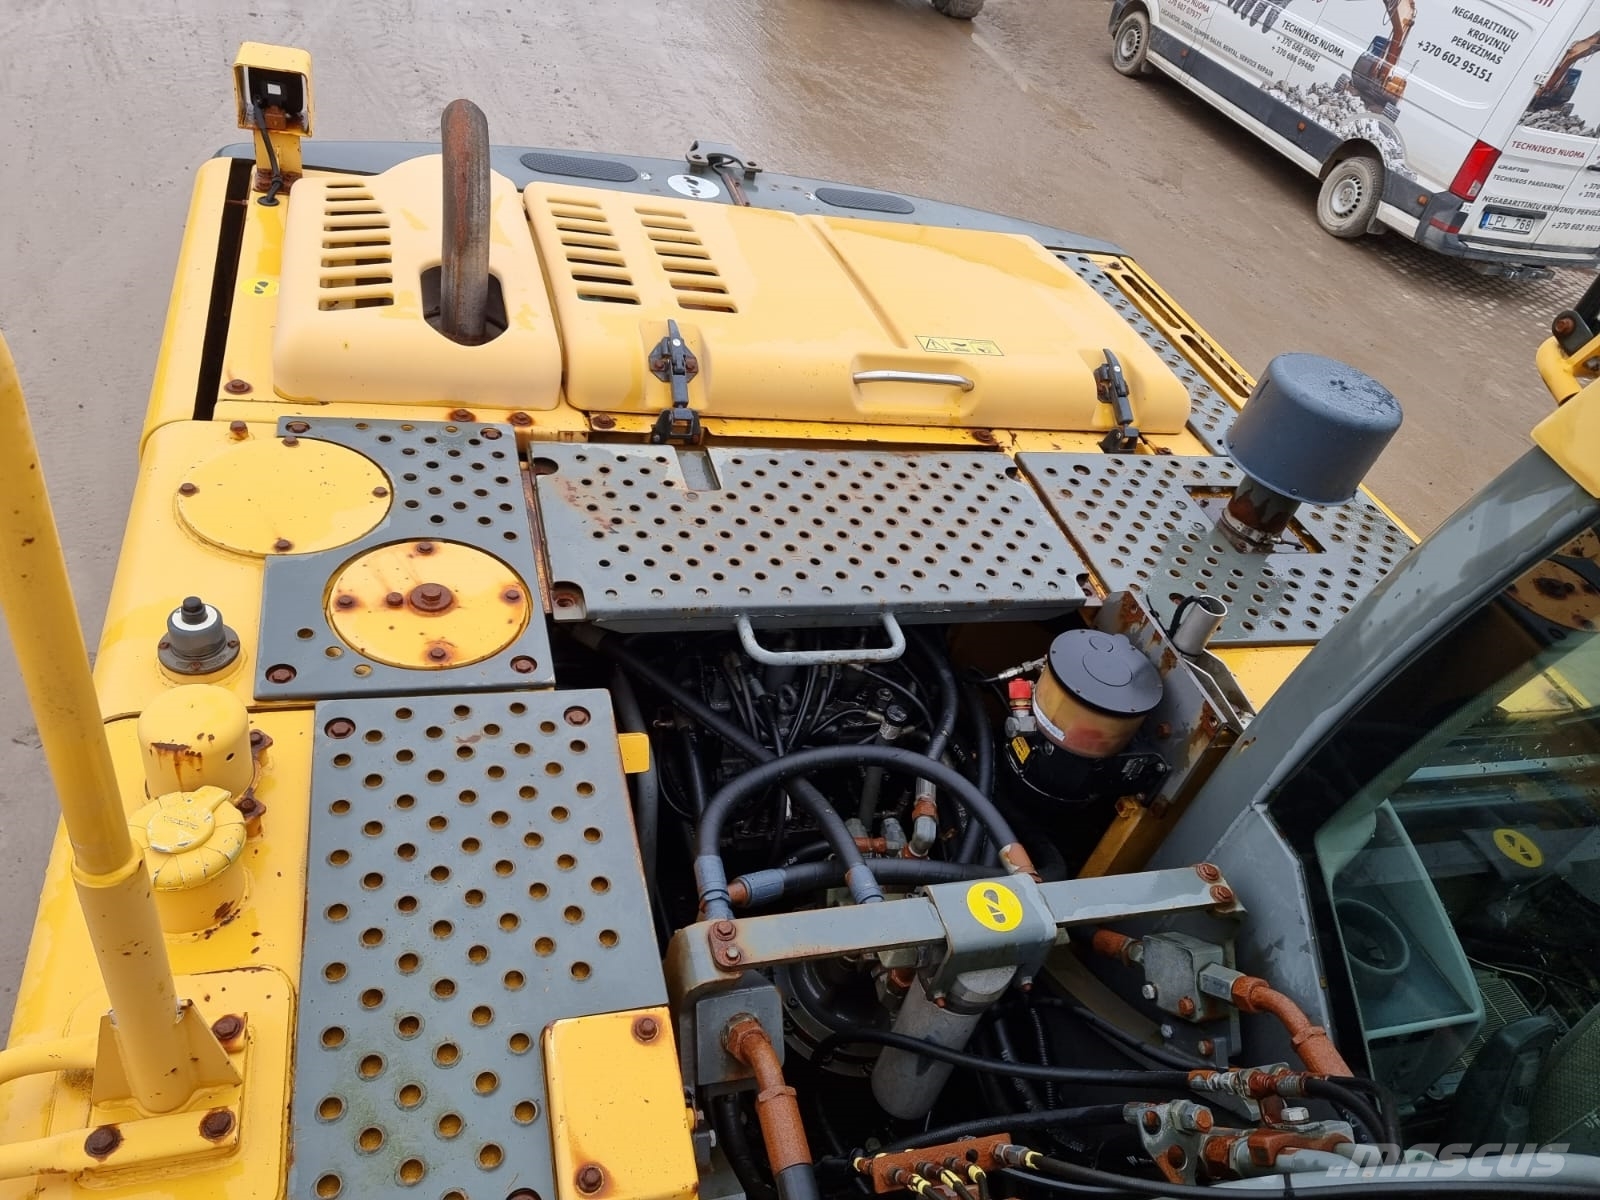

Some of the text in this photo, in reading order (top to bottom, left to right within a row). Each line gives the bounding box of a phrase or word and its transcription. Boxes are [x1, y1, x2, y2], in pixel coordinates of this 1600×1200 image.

[1451, 5, 1519, 41] NEGABARITINIŲ
[1281, 20, 1345, 59] TECHNIKOS NUOMA
[1450, 36, 1503, 65] PERVEŽIMAS
[1467, 27, 1512, 54] KROVINIŲ
[1416, 39, 1494, 83] +370 602 95151
[1511, 140, 1586, 159] TECHNIKOS NUOMA
[1482, 195, 1542, 210] NEGABARITINIŲ
[1487, 214, 1532, 231] LPL 768
